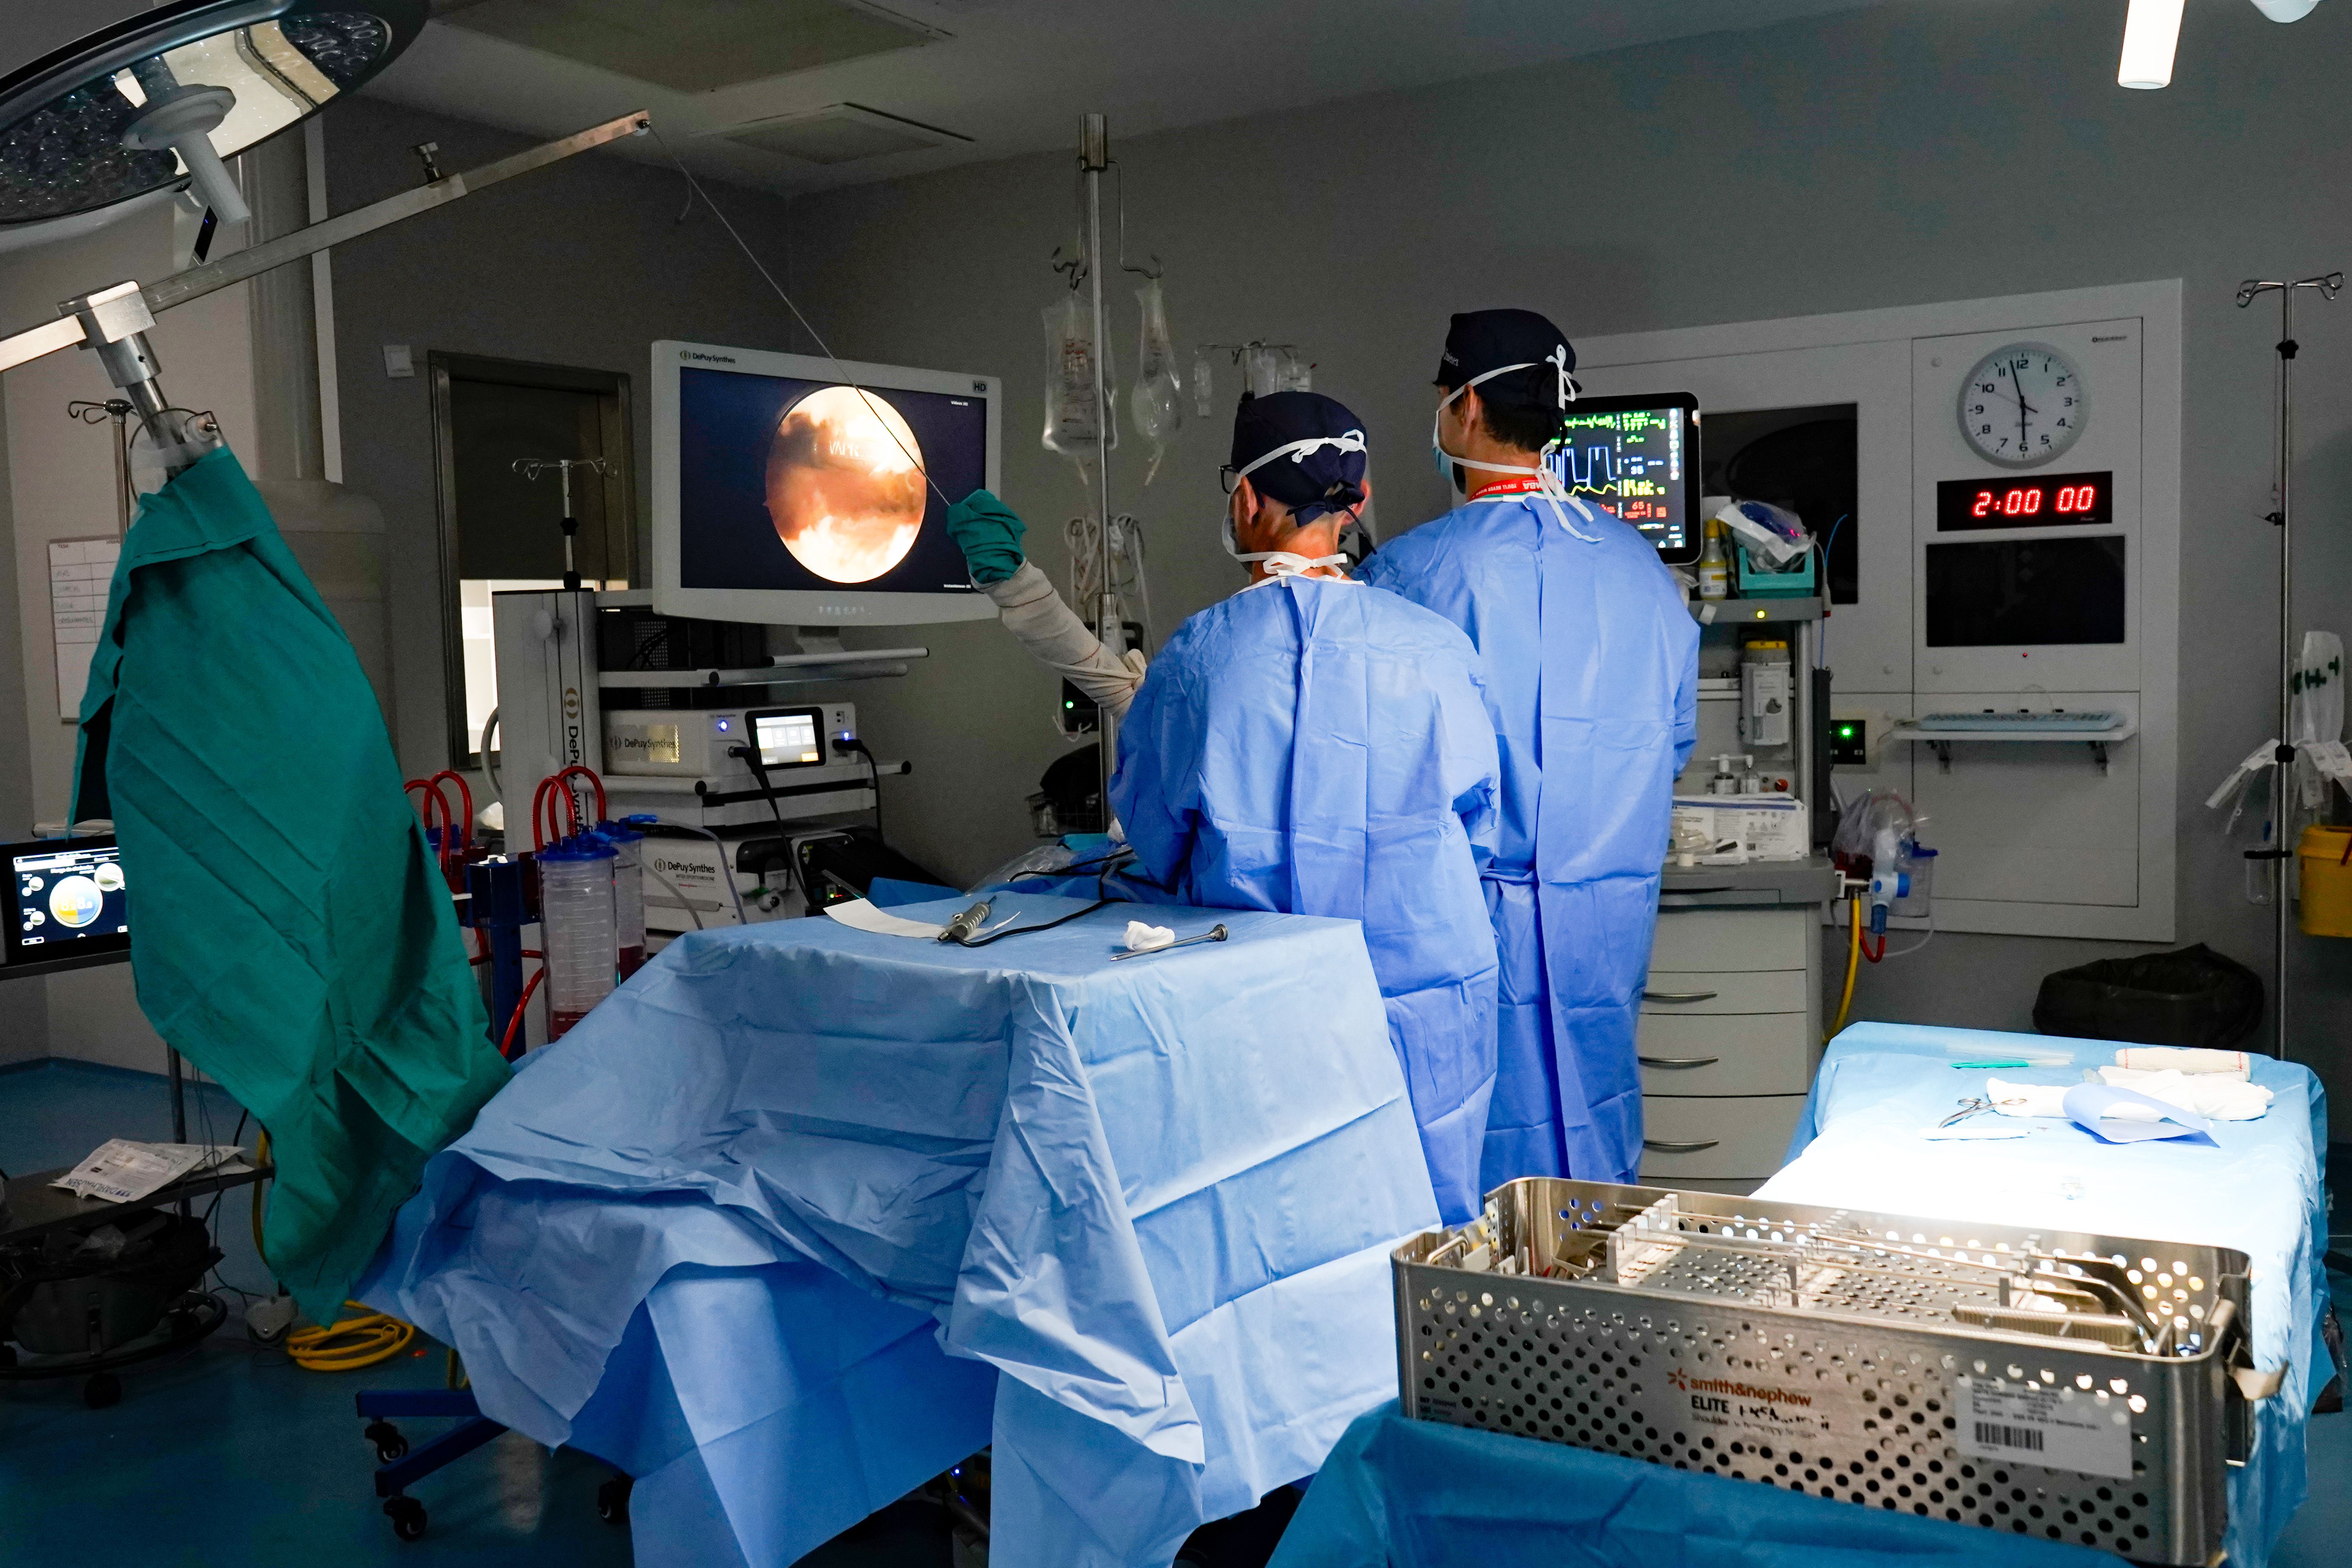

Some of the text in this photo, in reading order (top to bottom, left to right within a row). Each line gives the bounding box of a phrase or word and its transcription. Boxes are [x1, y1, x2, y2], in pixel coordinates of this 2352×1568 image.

[693, 353, 736, 363] DePuy Synthes
[2017, 359, 2029, 369] 12
[2044, 363, 2047, 372] 1
[1998, 367, 2006, 377] 11
[2056, 377, 2065, 387] 2
[974, 383, 986, 392] HD
[1982, 383, 1994, 393] 10
[2064, 397, 2073, 407] 3
[1975, 405, 1984, 414] 9
[2057, 418, 2066, 426] 4
[1982, 424, 1991, 434] 8
[2000, 437, 2008, 448] 7
[2041, 434, 2049, 445] 5
[2019, 443, 2028, 452] 6
[1630, 465, 1644, 475] 35
[1632, 501, 1645, 510] 65
[1974, 486, 2094, 517] 2:00 00
[624, 738, 647, 751] DePuy
[668, 862, 715, 874] DePuy Synthes
[1690, 1378, 1812, 1407] smith&nephew
[1691, 1395, 1730, 1414] ELITE
